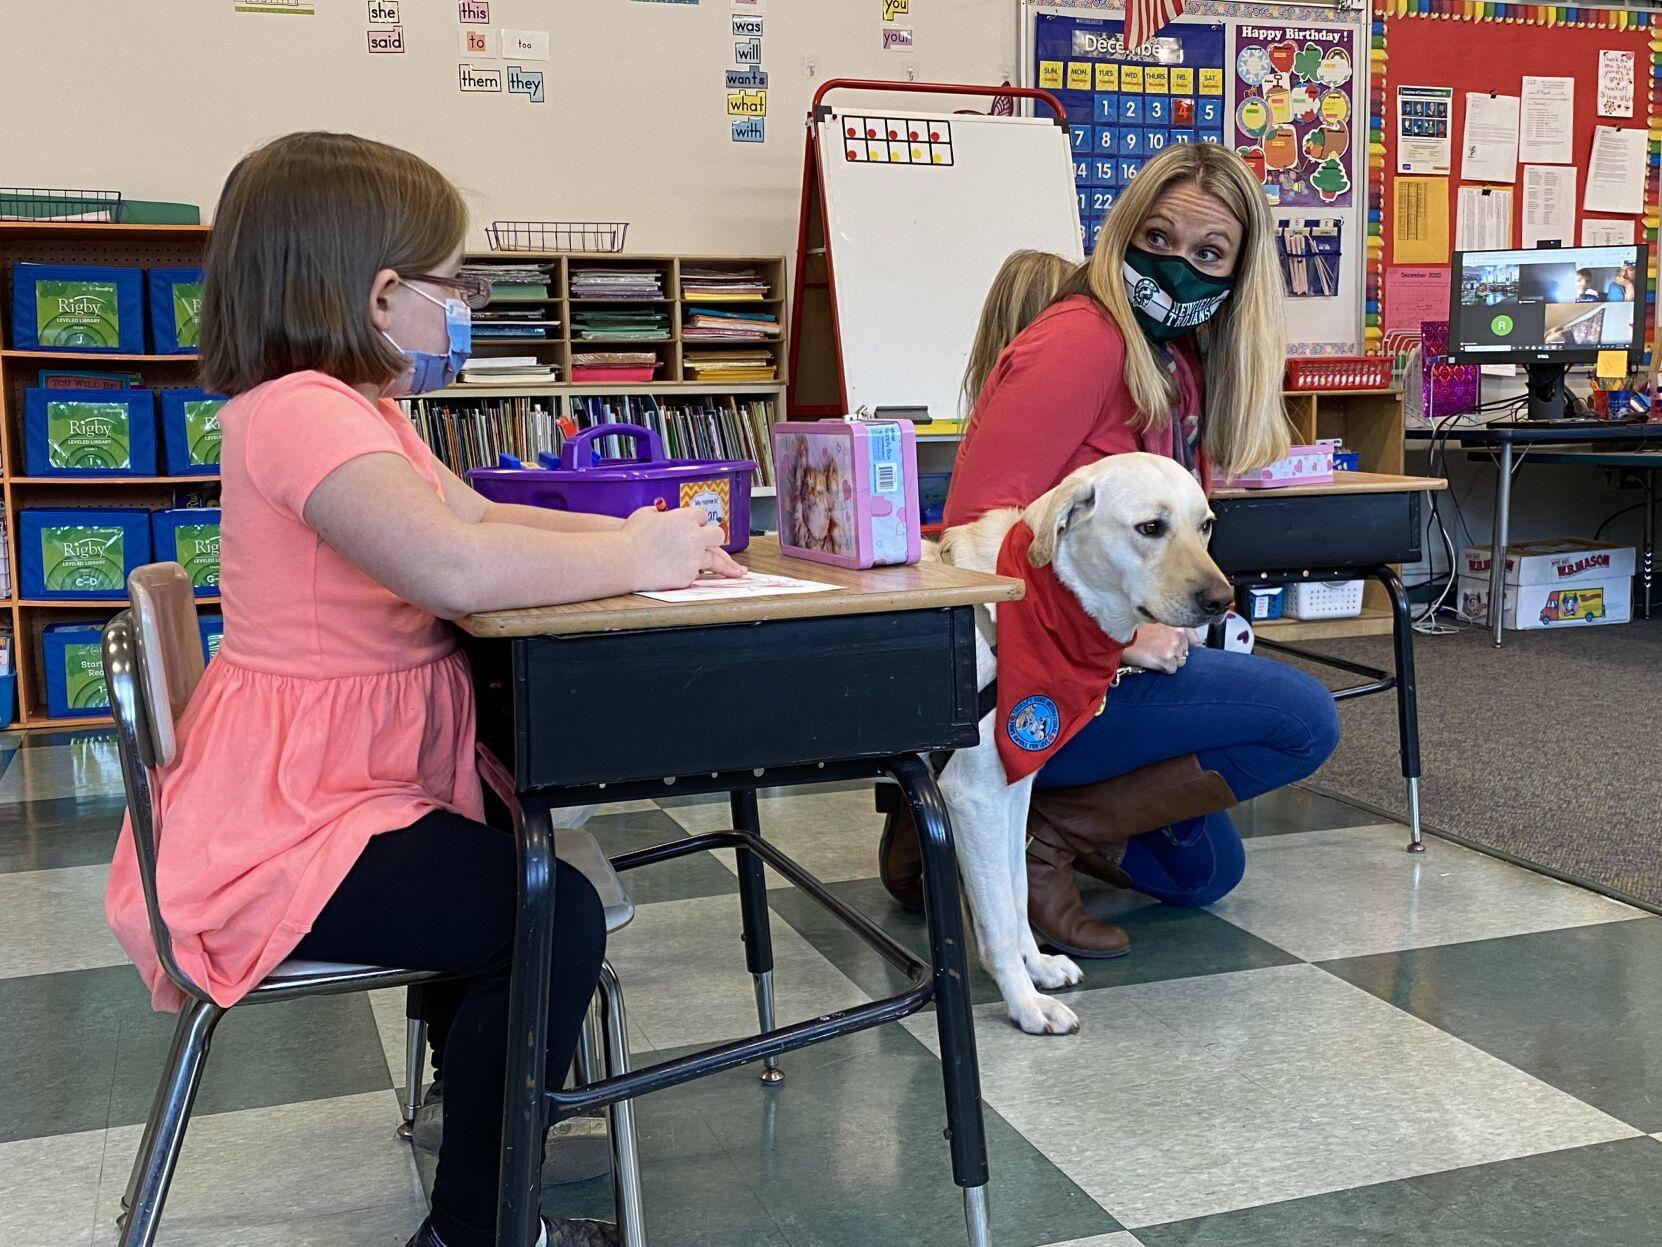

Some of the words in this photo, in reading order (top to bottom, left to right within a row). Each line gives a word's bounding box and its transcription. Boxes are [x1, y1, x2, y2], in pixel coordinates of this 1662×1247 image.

[371, 2, 395, 18] she
[462, 2, 486, 19] this
[885, 0, 906, 14] you
[735, 22, 760, 32] was
[1242, 26, 1282, 40] Happy
[1285, 28, 1340, 43] Birthday
[371, 32, 401, 48] said
[469, 35, 484, 48] to
[519, 39, 531, 49] too
[1085, 35, 1163, 57] Decebe
[738, 44, 758, 60] will
[462, 71, 498, 87] them
[510, 73, 540, 96] they
[727, 71, 765, 85] wants
[731, 96, 764, 112] what
[1102, 101, 1110, 115] 1
[1126, 102, 1135, 117] 2
[1152, 102, 1161, 117] 3
[1204, 105, 1214, 120] 5
[736, 123, 761, 138] with
[1075, 131, 1084, 146] 7
[1102, 132, 1111, 147] 8
[1127, 134, 1136, 149] 9
[1149, 134, 1163, 149] 10
[1097, 163, 1111, 178] 15
[1122, 164, 1137, 179] 16
[1094, 194, 1112, 209] 22
[58, 298, 100, 316] Rigby
[1166, 309, 1210, 327] TROJANS
[77, 333, 84, 344] J
[69, 420, 111, 438] Rigby
[63, 541, 104, 558] Rigby
[195, 540, 221, 556] Rig
